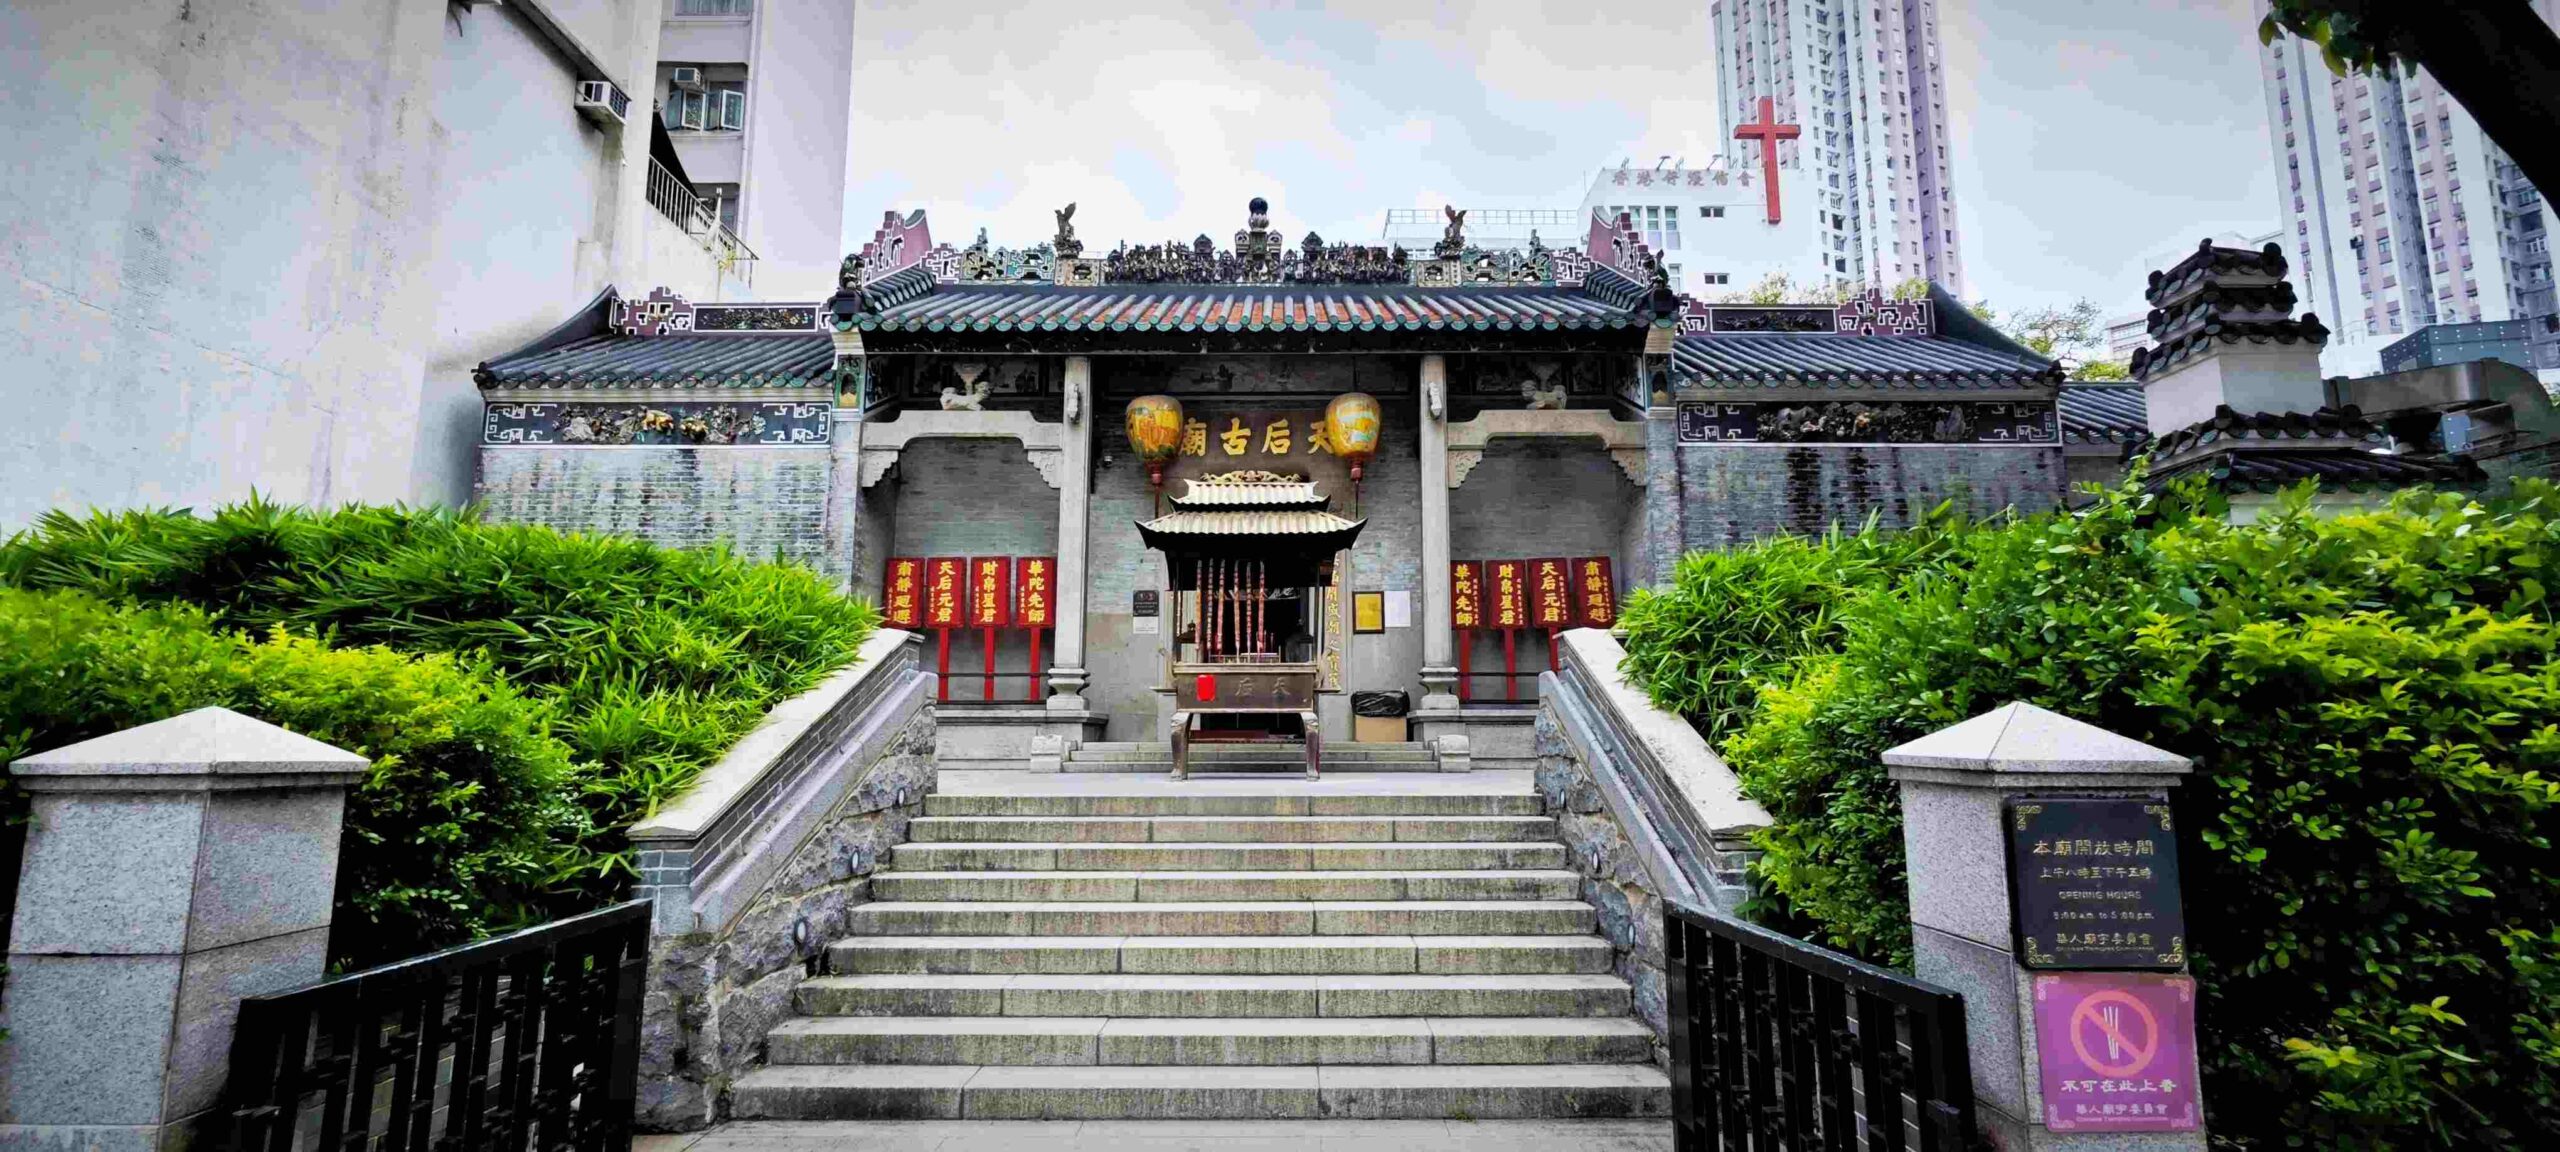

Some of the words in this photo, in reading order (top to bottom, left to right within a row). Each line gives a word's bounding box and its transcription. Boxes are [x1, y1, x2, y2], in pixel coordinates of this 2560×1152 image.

[935, 561, 956, 623] 天后元君
[980, 561, 998, 623] 財帛星君
[1028, 560, 1045, 623] 華陀先師
[1454, 564, 1473, 626] 華陀先師
[1498, 563, 1515, 625] 財帛星君
[1540, 561, 1560, 622] 天后元君
[2033, 840, 2153, 856] 本廟開放時間
[2040, 867, 2152, 879] 上午八時至下午五時
[2059, 891, 2103, 899] OPENING
[2106, 891, 2142, 899] HOURS
[2061, 1079, 2176, 1093] 不可在此上香
